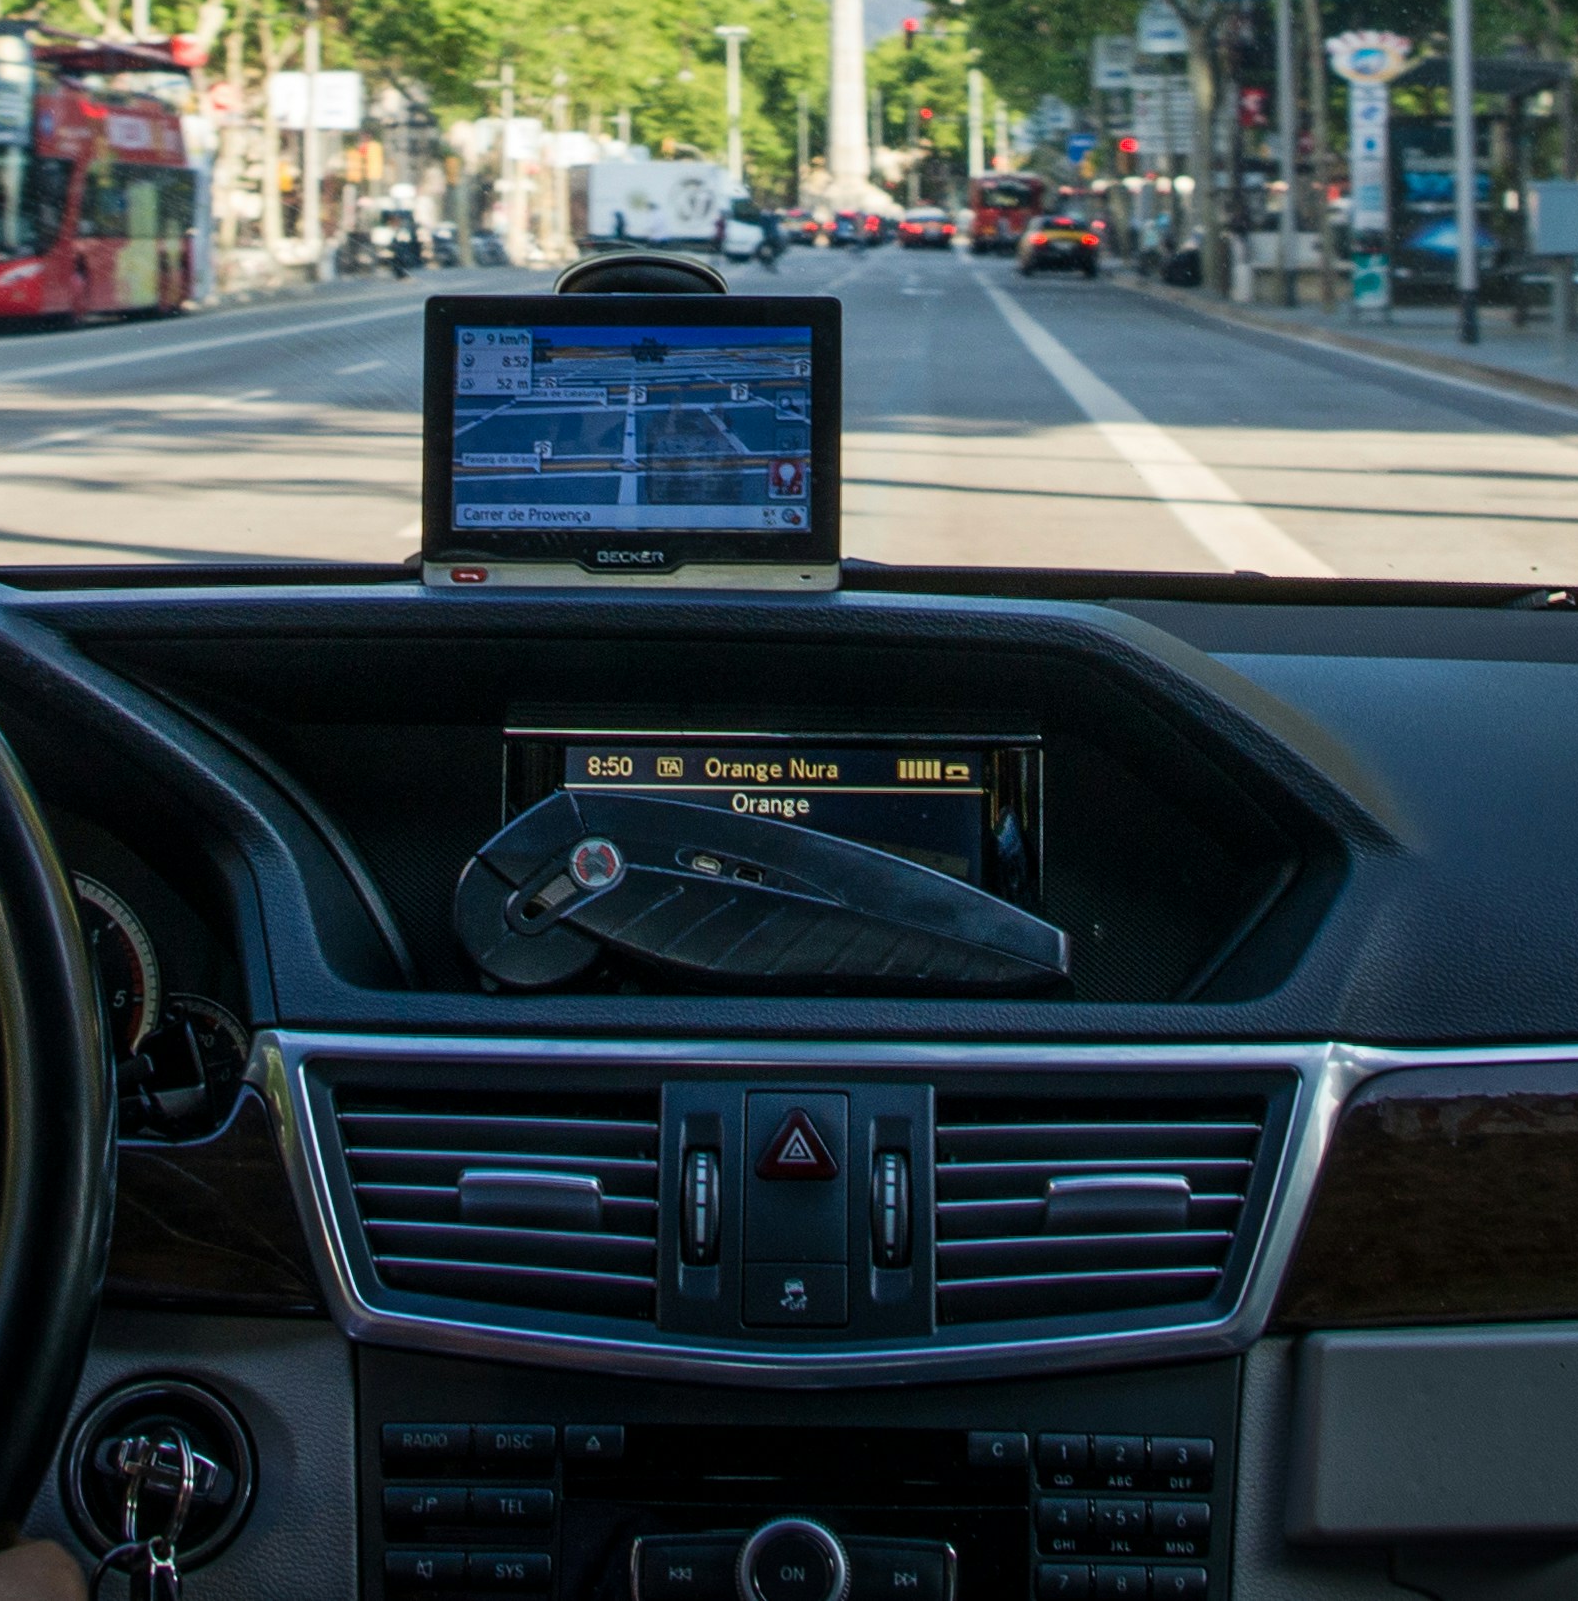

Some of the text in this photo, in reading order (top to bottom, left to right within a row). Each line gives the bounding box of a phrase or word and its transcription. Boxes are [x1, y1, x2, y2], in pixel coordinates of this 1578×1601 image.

[486, 332, 530, 345] 9 km/h
[502, 356, 529, 368] 8:52
[497, 378, 529, 390] 52 m
[463, 508, 591, 525] Carrer de Provença
[597, 550, 664, 563] BECKER
[587, 756, 839, 782] 8:50 TA Orange Nura
[731, 793, 810, 816] Orange
[112, 989, 128, 1009] 5
[402, 1432, 448, 1448] RADIO
[495, 1433, 533, 1450] DISC
[1060, 1443, 1068, 1461] 1
[1116, 1445, 1126, 1463] 2
[1177, 1447, 1188, 1465] 3
[1106, 1475, 1134, 1488] ABC
[1168, 1476, 1193, 1490] DEF
[499, 1498, 526, 1514] TEL
[1058, 1509, 1068, 1524] 4
[1176, 1512, 1187, 1529] 6
[1052, 1539, 1076, 1552] GHI
[1109, 1540, 1132, 1553] JKL
[1165, 1541, 1195, 1555] MNO
[494, 1562, 526, 1579] SYS
[779, 1567, 806, 1582] ON
[1058, 1574, 1069, 1591] 7
[1116, 1575, 1127, 1593] 8
[1175, 1576, 1186, 1594] 9
